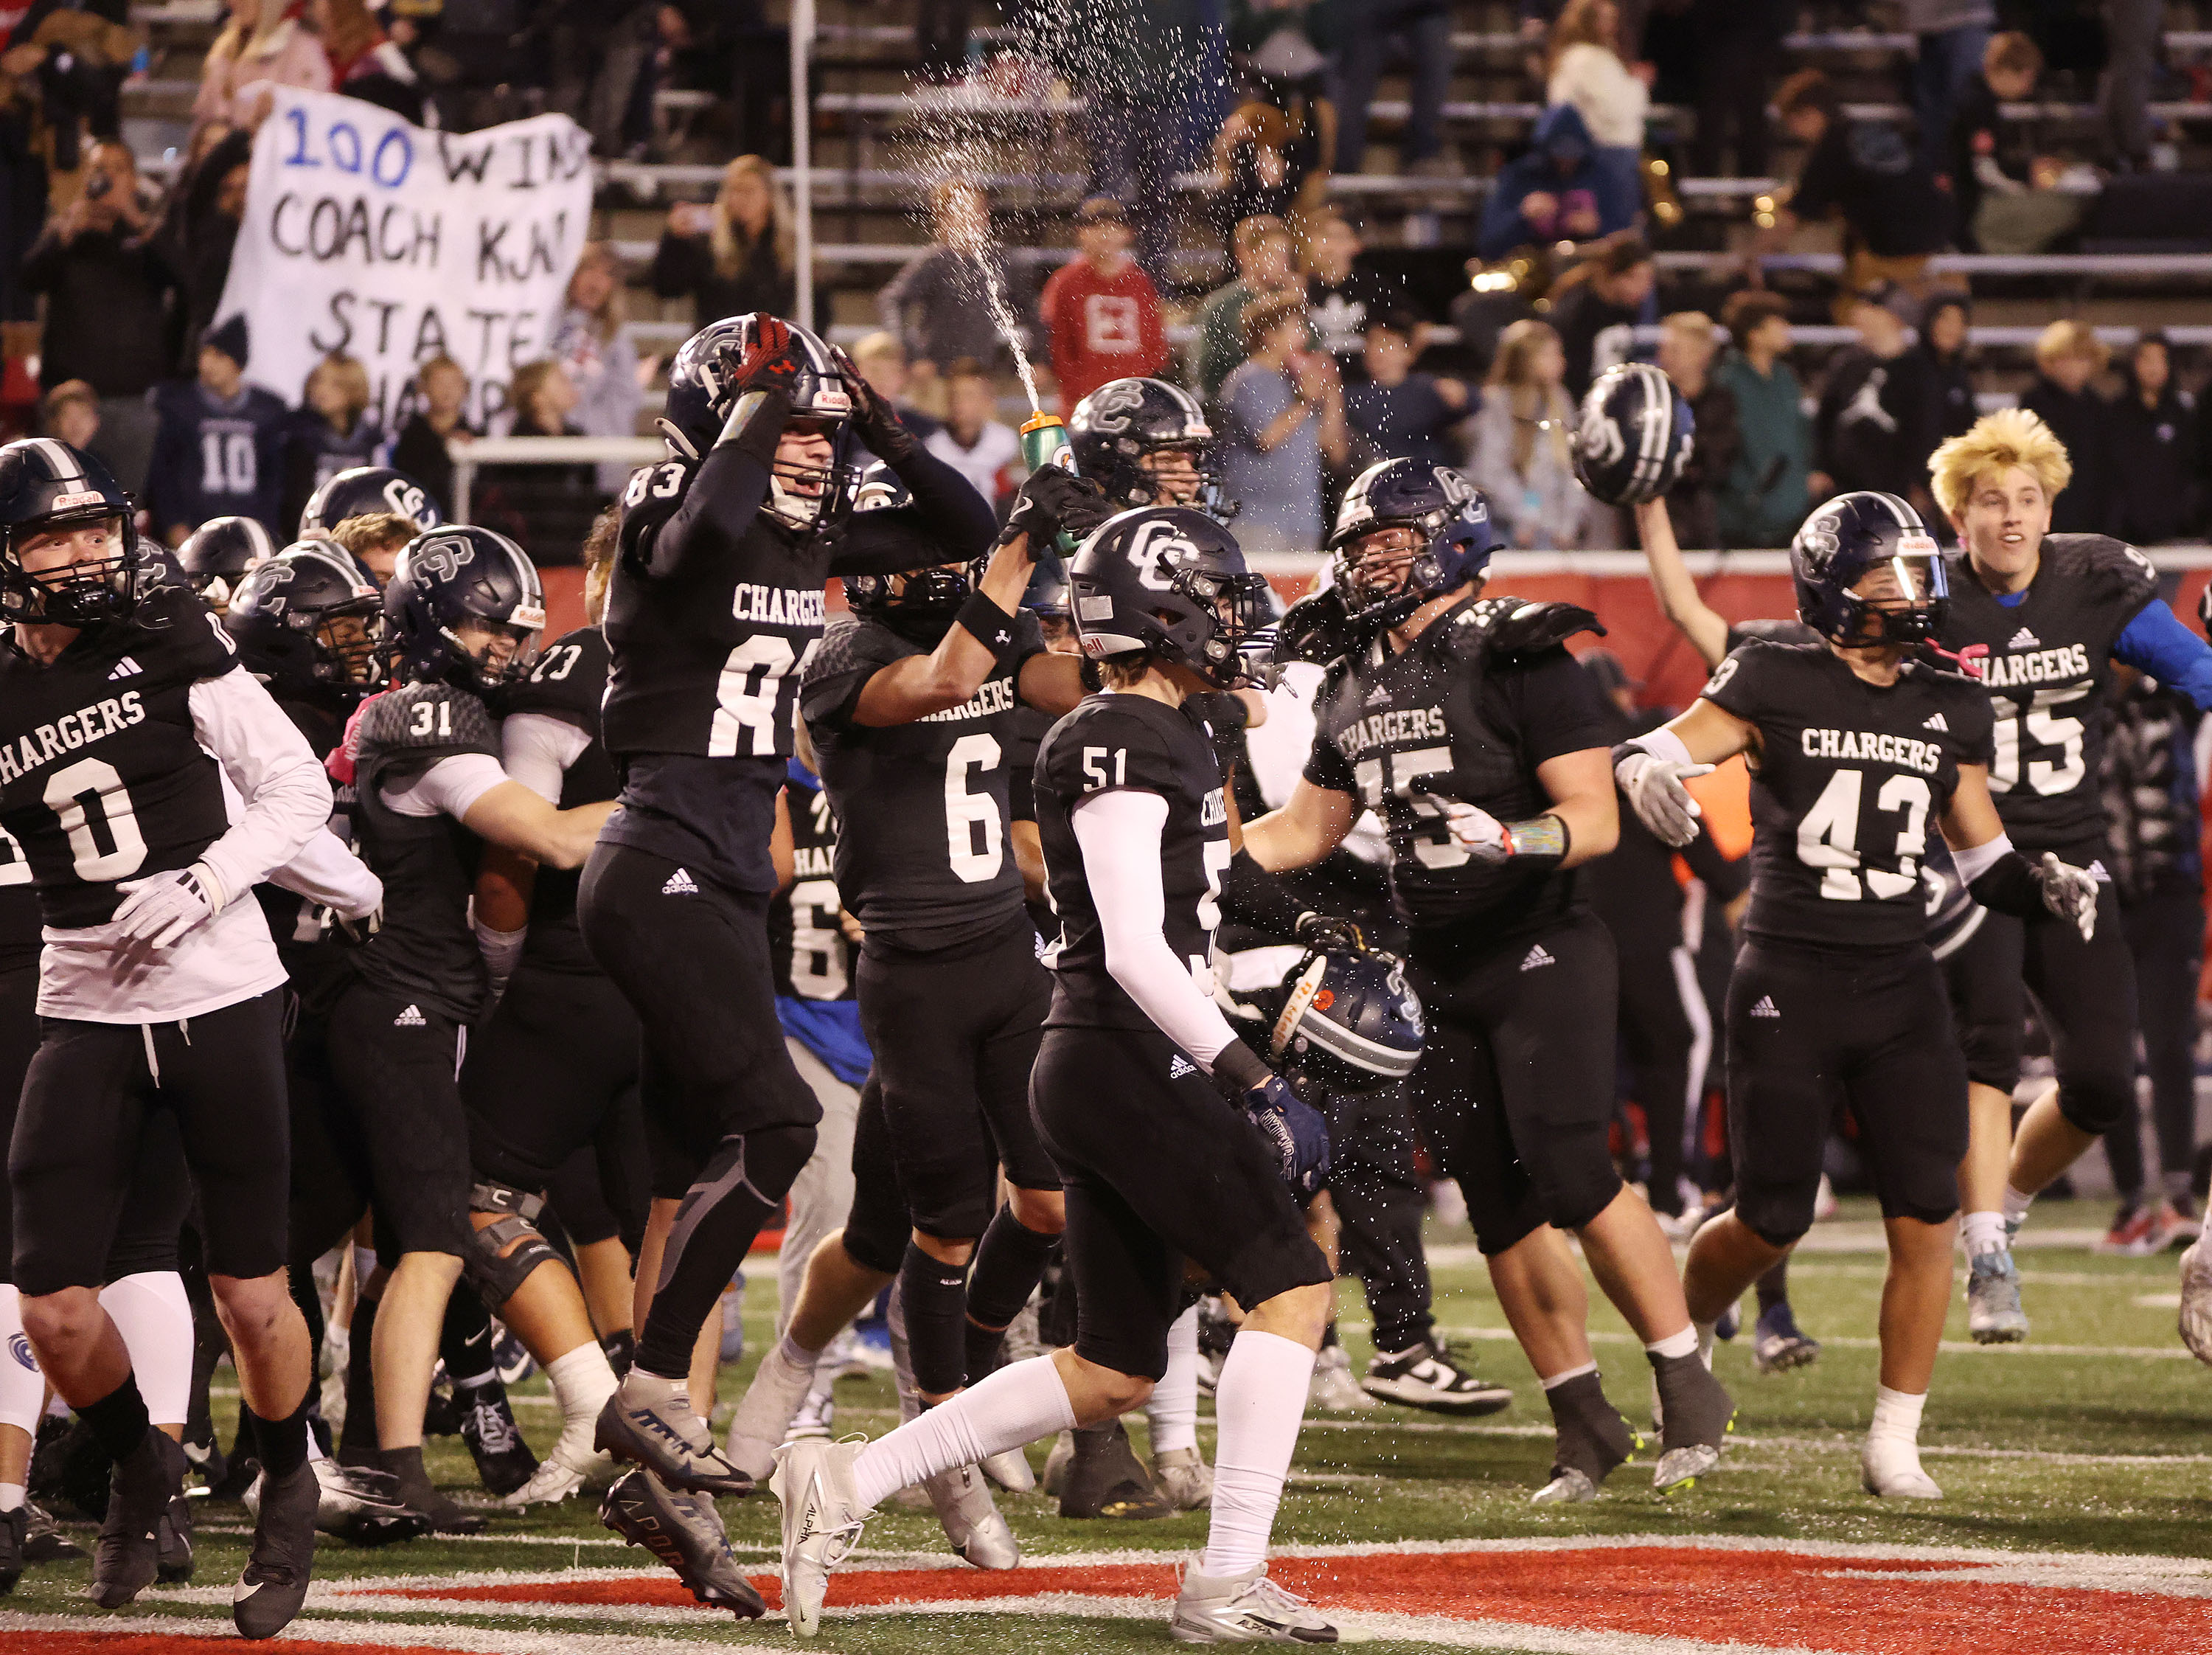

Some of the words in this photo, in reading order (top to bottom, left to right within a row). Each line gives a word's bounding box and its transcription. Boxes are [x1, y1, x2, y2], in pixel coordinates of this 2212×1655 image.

[284, 105, 413, 190] 100
[271, 191, 442, 270] COACH
[308, 288, 537, 369] STATE
[202, 431, 258, 494] 10
[624, 462, 686, 509] 83
[409, 701, 453, 737] 31
[1338, 707, 1447, 761] CHARGERS
[1082, 746, 1127, 793] 51
[1801, 727, 1942, 774] CHARGERS
[42, 757, 149, 883] 0
[944, 732, 1004, 884] 6
[1796, 768, 1933, 901] 43
[661, 883, 699, 895] adidas
[797, 1502, 817, 1545] ALPHA
